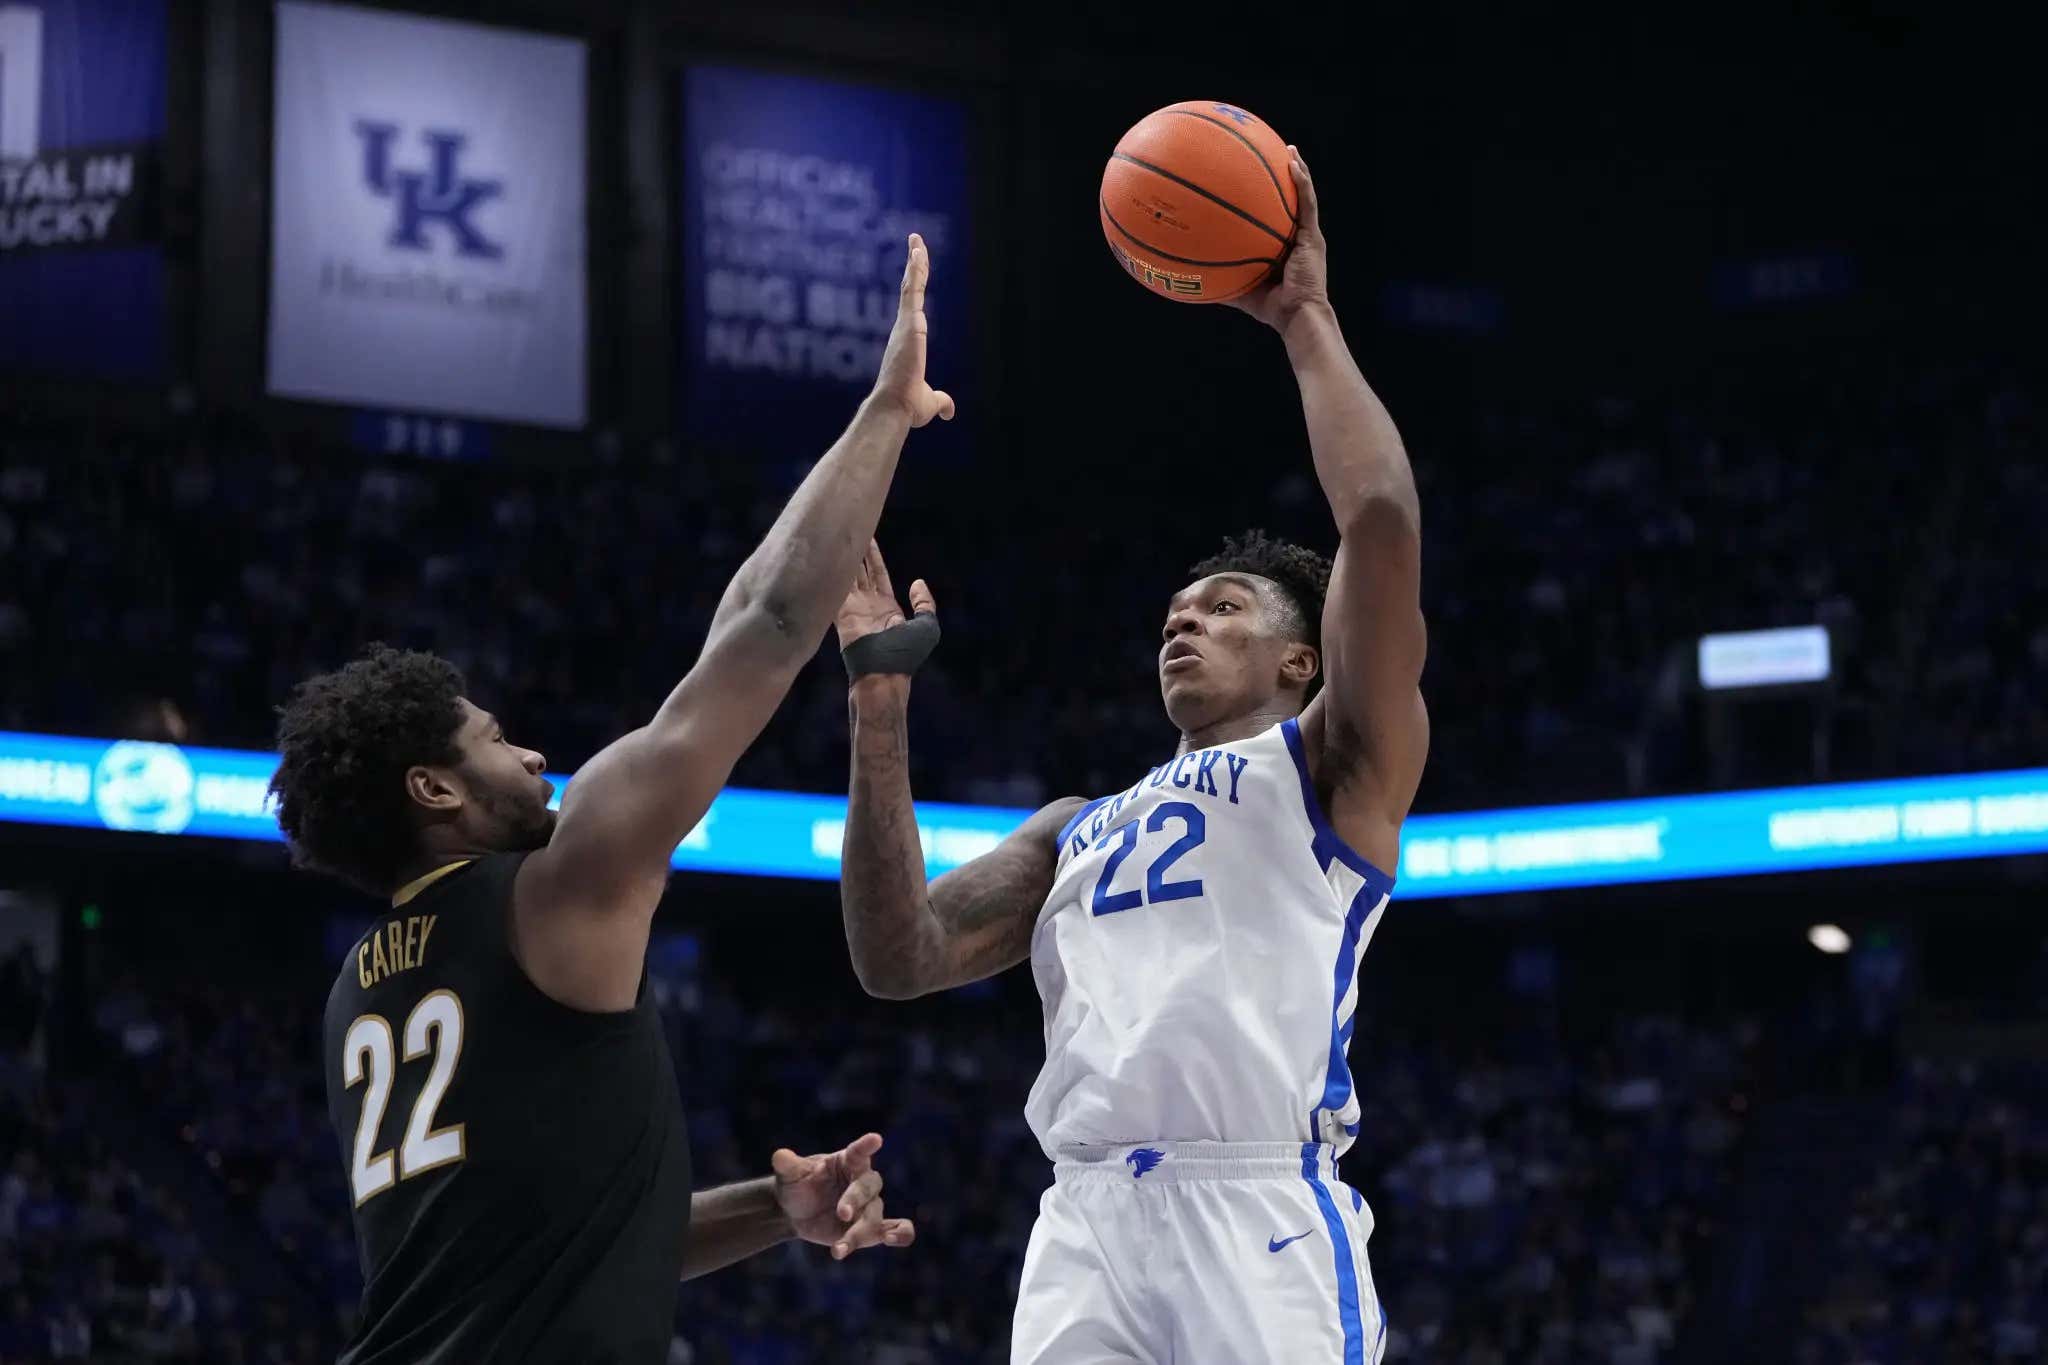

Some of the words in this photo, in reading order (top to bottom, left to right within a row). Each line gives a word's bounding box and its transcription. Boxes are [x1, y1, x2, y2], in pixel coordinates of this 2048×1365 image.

[83, 153, 134, 198] IN
[354, 119, 506, 260] UK
[705, 268, 795, 324] BIG
[807, 280, 905, 336] BLU
[1092, 801, 1206, 917] 22
[357, 914, 439, 990] CAREY
[343, 988, 467, 1209] 22
